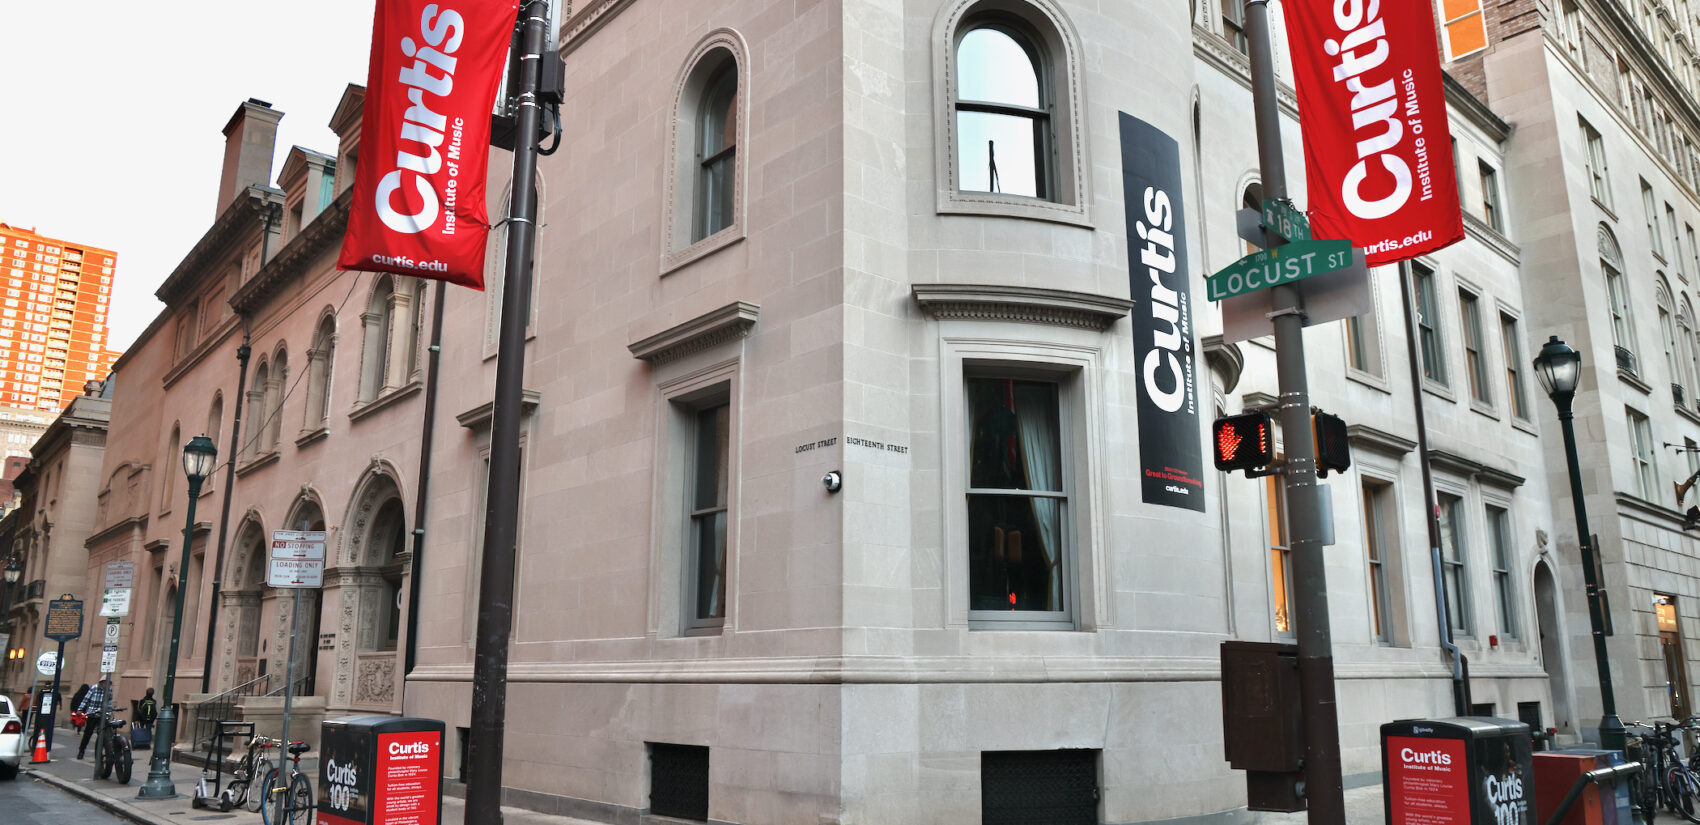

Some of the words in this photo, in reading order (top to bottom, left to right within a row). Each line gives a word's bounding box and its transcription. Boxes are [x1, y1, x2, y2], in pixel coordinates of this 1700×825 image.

[1402, 68, 1420, 117] Music
[375, 3, 464, 234] Curtis
[1324, 0, 1413, 219] Curtis
[447, 117, 464, 160] Music
[1409, 118, 1422, 135] of
[448, 160, 459, 177] of
[1415, 137, 1433, 201] Institute
[442, 180, 457, 235] Institute
[1363, 229, 1433, 255] urtis.edu
[372, 253, 448, 272] curtis.edu
[1212, 252, 1316, 298] LOCUST
[1328, 251, 1345, 268] ST
[1135, 186, 1185, 413] Curtis
[1181, 291, 1189, 334] Music
[1183, 335, 1190, 353] of
[1186, 355, 1194, 414] Institute
[795, 443, 816, 453] LOCUST
[817, 437, 837, 448] STREET
[887, 444, 908, 454] STREET
[389, 742, 429, 755] Curtis
[1401, 748, 1452, 765] Curtis
[327, 759, 356, 786] Curtis
[330, 783, 349, 811] 100
[1487, 771, 1522, 803] Curtis
[1495, 801, 1519, 825] 100
